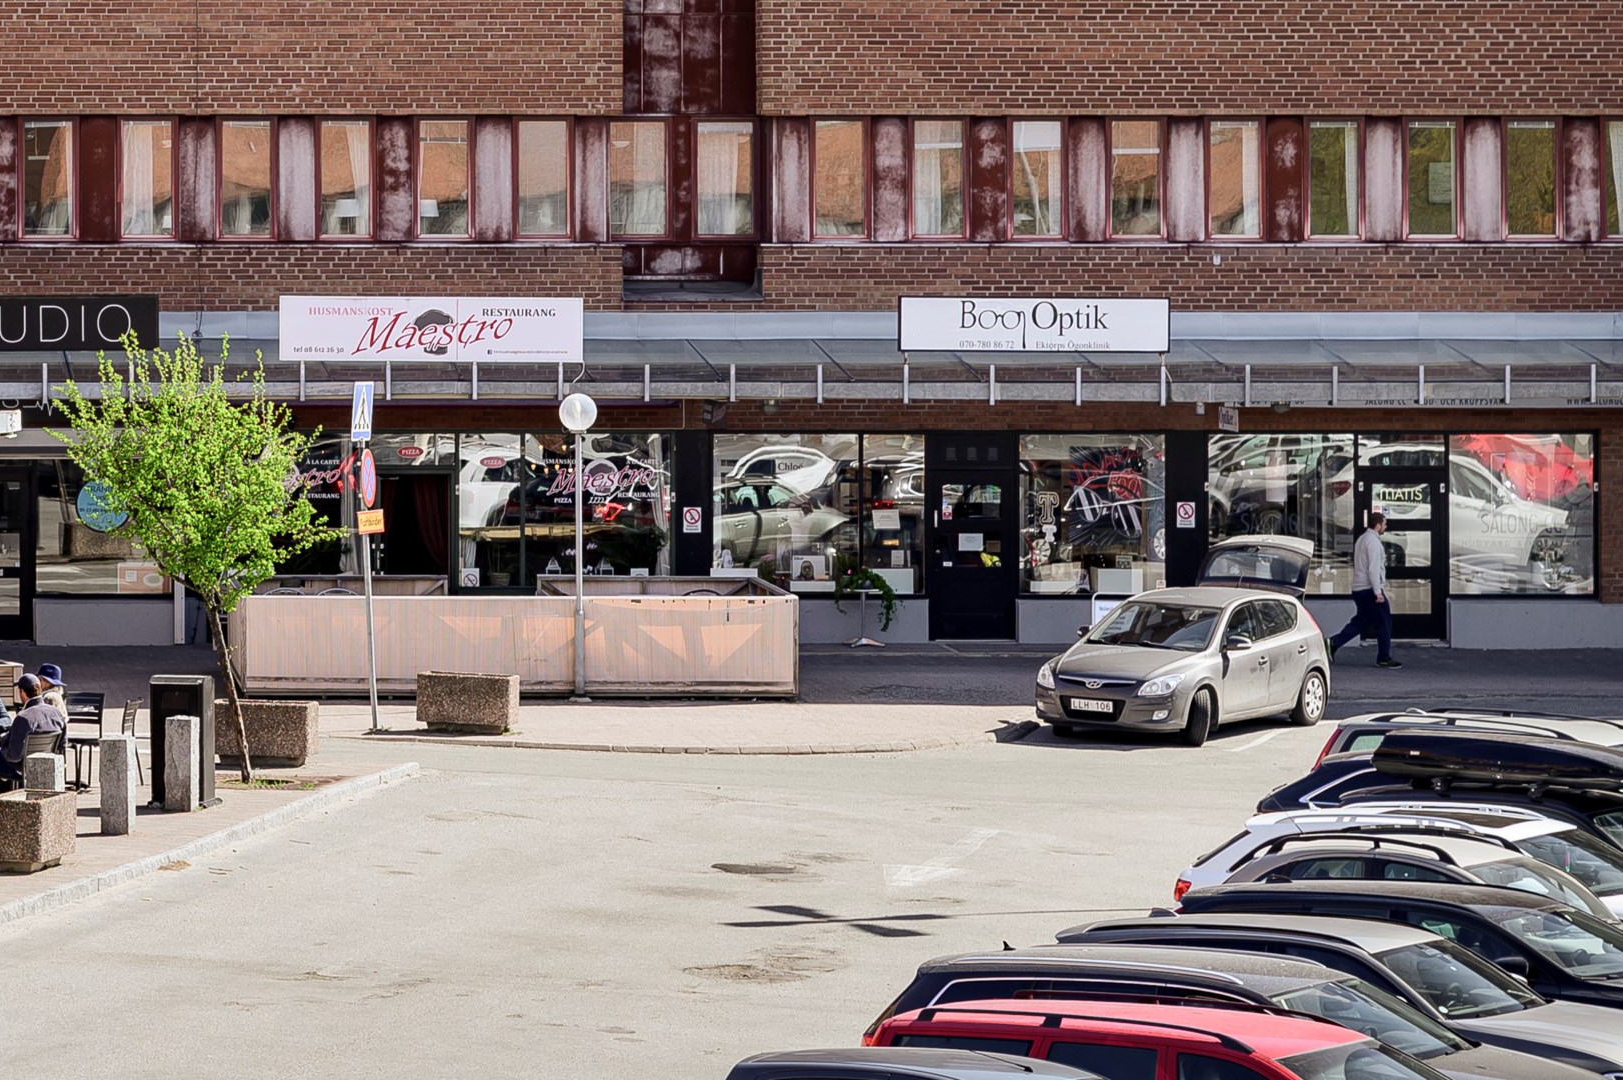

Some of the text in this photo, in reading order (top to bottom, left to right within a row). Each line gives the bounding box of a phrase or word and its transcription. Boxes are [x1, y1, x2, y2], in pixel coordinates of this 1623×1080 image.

[308, 307, 393, 316] HUSMANSKOST
[482, 307, 556, 317] RESTAURANG
[1031, 301, 1109, 336] Optik
[351, 311, 514, 355] Maestro
[293, 345, 303, 353] tel
[336, 346, 345, 354] 30
[959, 341, 1015, 349] 070-780 86 72
[1035, 340, 1111, 351] Ektorps Ögonklinik
[1480, 513, 1538, 534] SALONG
[1072, 699, 1111, 711] LLH 106
